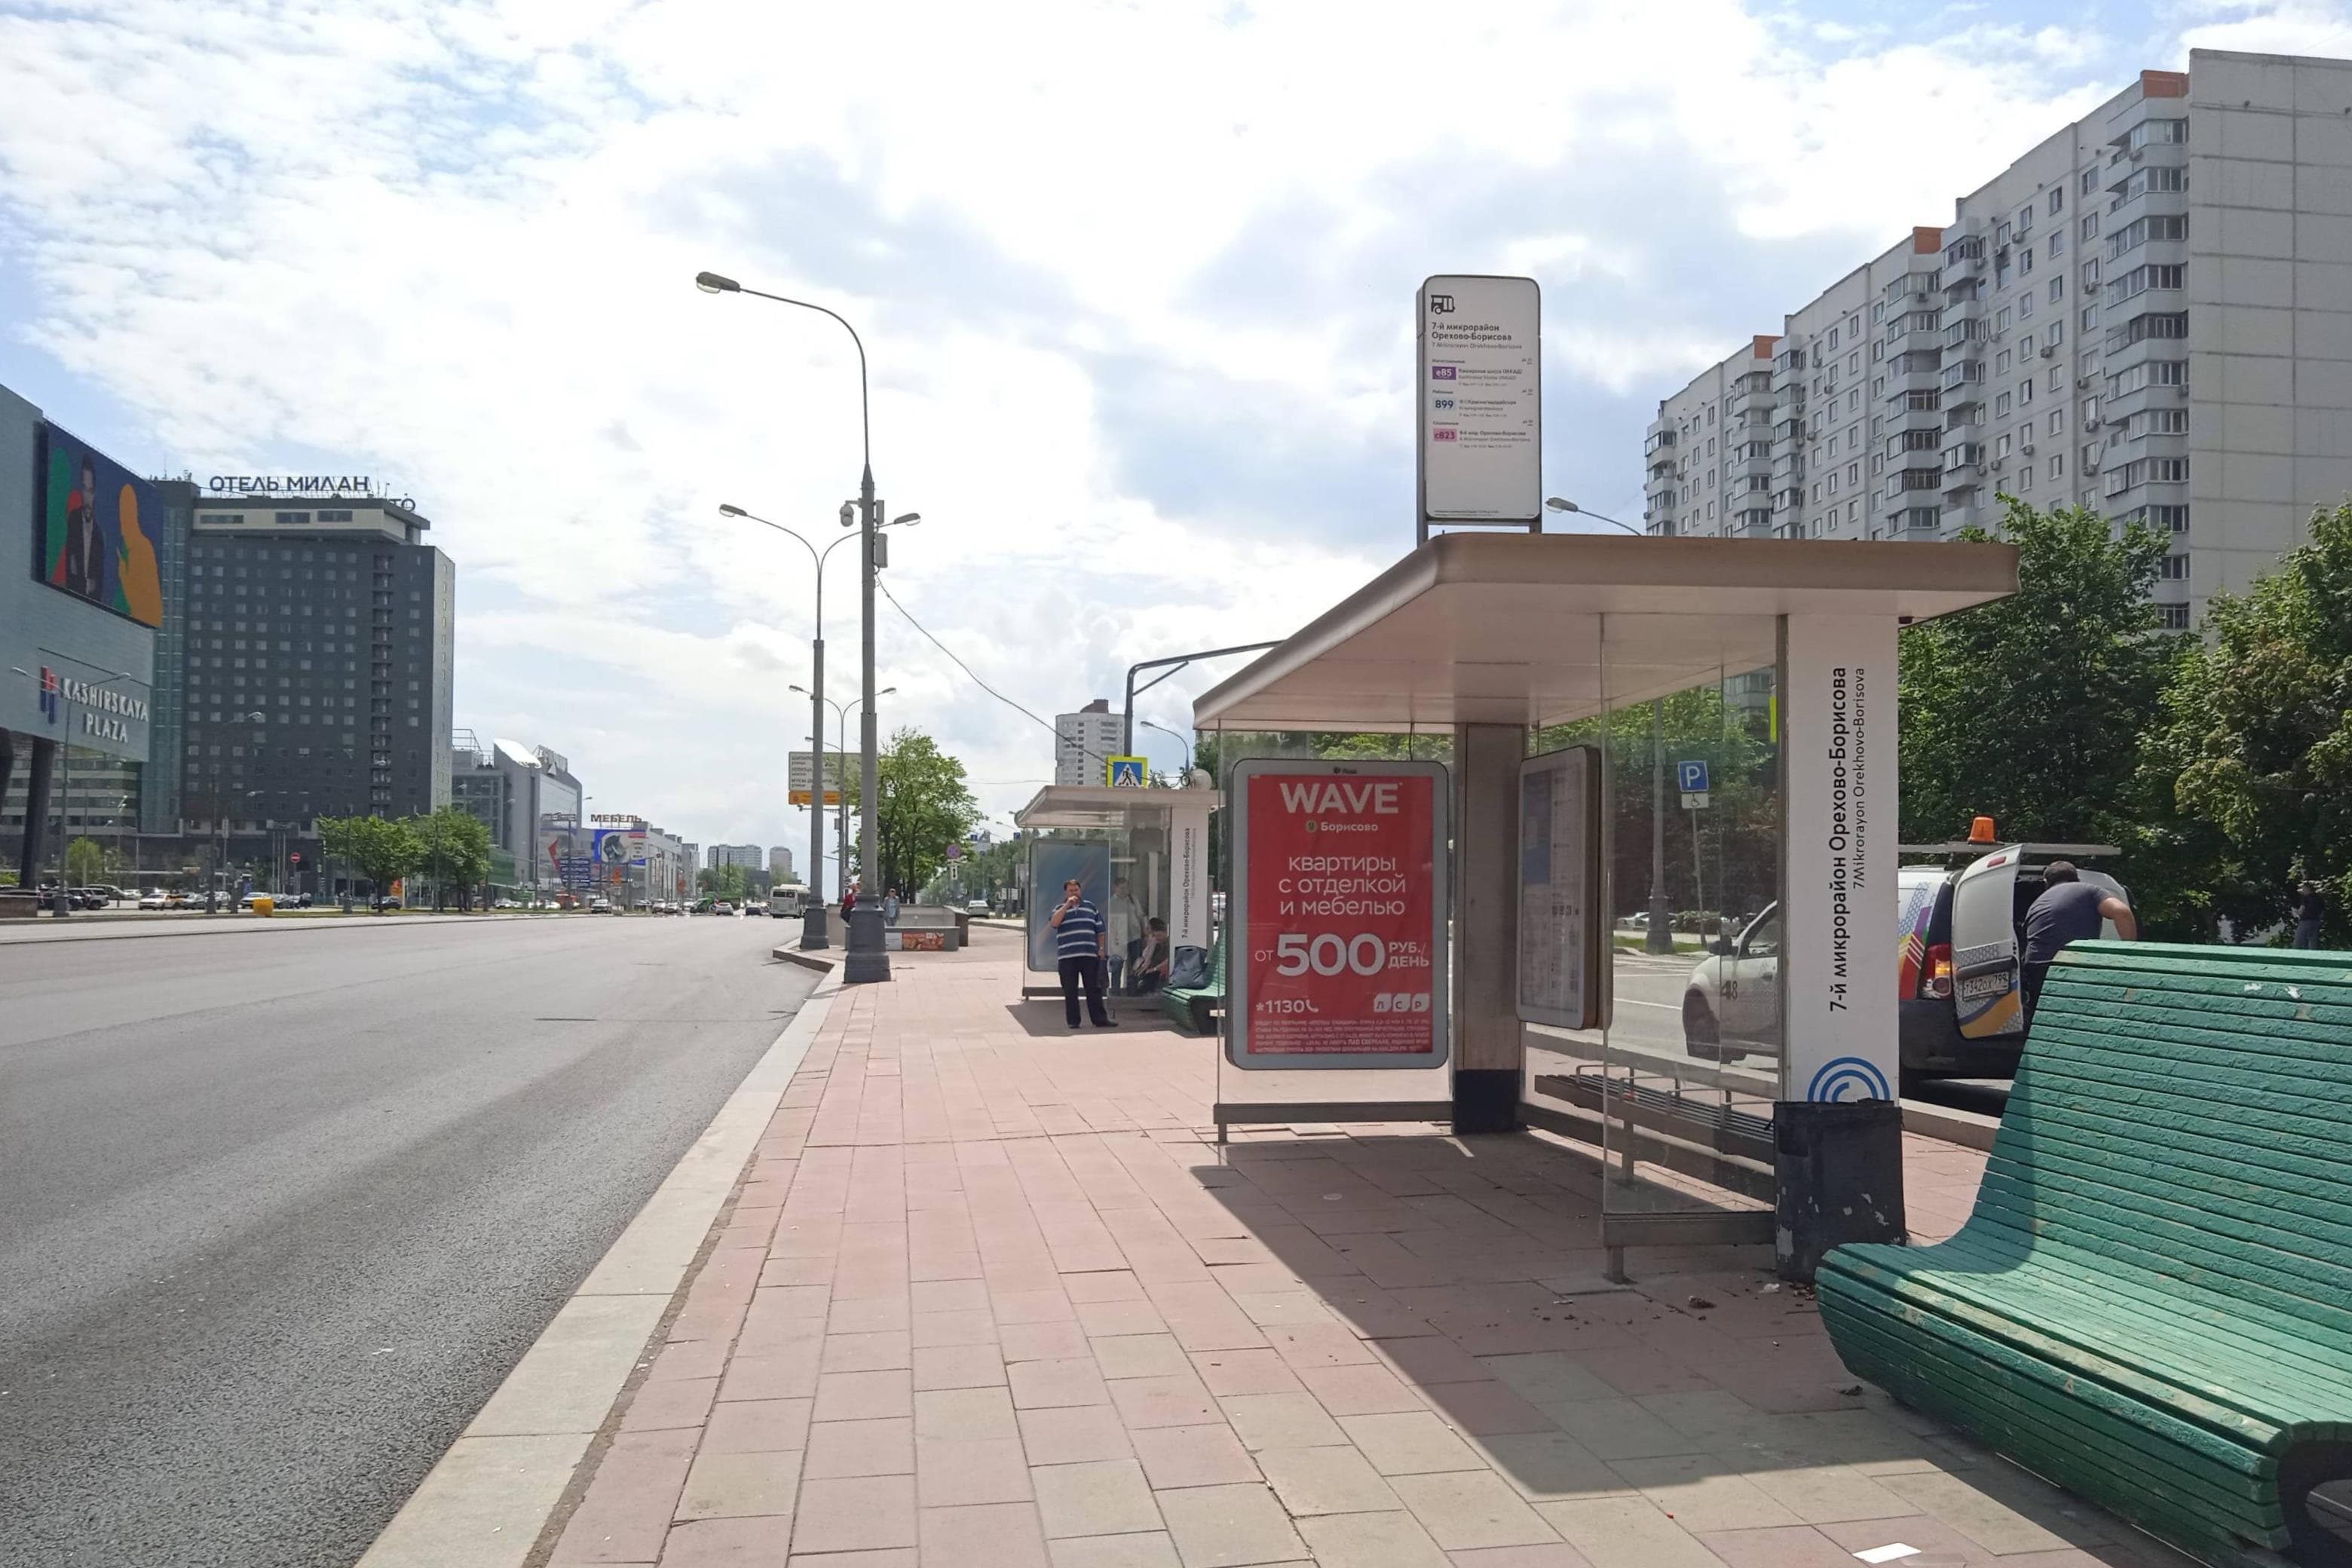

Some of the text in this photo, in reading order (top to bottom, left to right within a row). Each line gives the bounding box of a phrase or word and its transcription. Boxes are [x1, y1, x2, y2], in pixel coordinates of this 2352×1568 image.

[1432, 332, 1512, 341] Орехово-Борисова
[1446, 323, 1499, 332] микрорайон
[1435, 400, 1454, 409] 899
[210, 476, 369, 492] ОТЕЛЬ МИЛАН
[62, 678, 149, 722] KASHIRSKAYA
[85, 713, 128, 743] PLAZA
[1853, 668, 1866, 797] Orekhovo-Borisova
[1686, 765, 1701, 788] P
[590, 813, 642, 823] МЕБЕЛЬ
[1321, 822, 1379, 833] Борисово
[1829, 667, 1851, 1012] 7-й микрорайон Орехово-Борисова
[1289, 856, 1396, 876] квартиры
[1279, 873, 1407, 896] с отделкой
[1280, 896, 1406, 915] и мебелью
[1276, 933, 1386, 976] 500
[1388, 956, 1429, 969] ДЕНЬ
[1720, 980, 1738, 1000] 48
